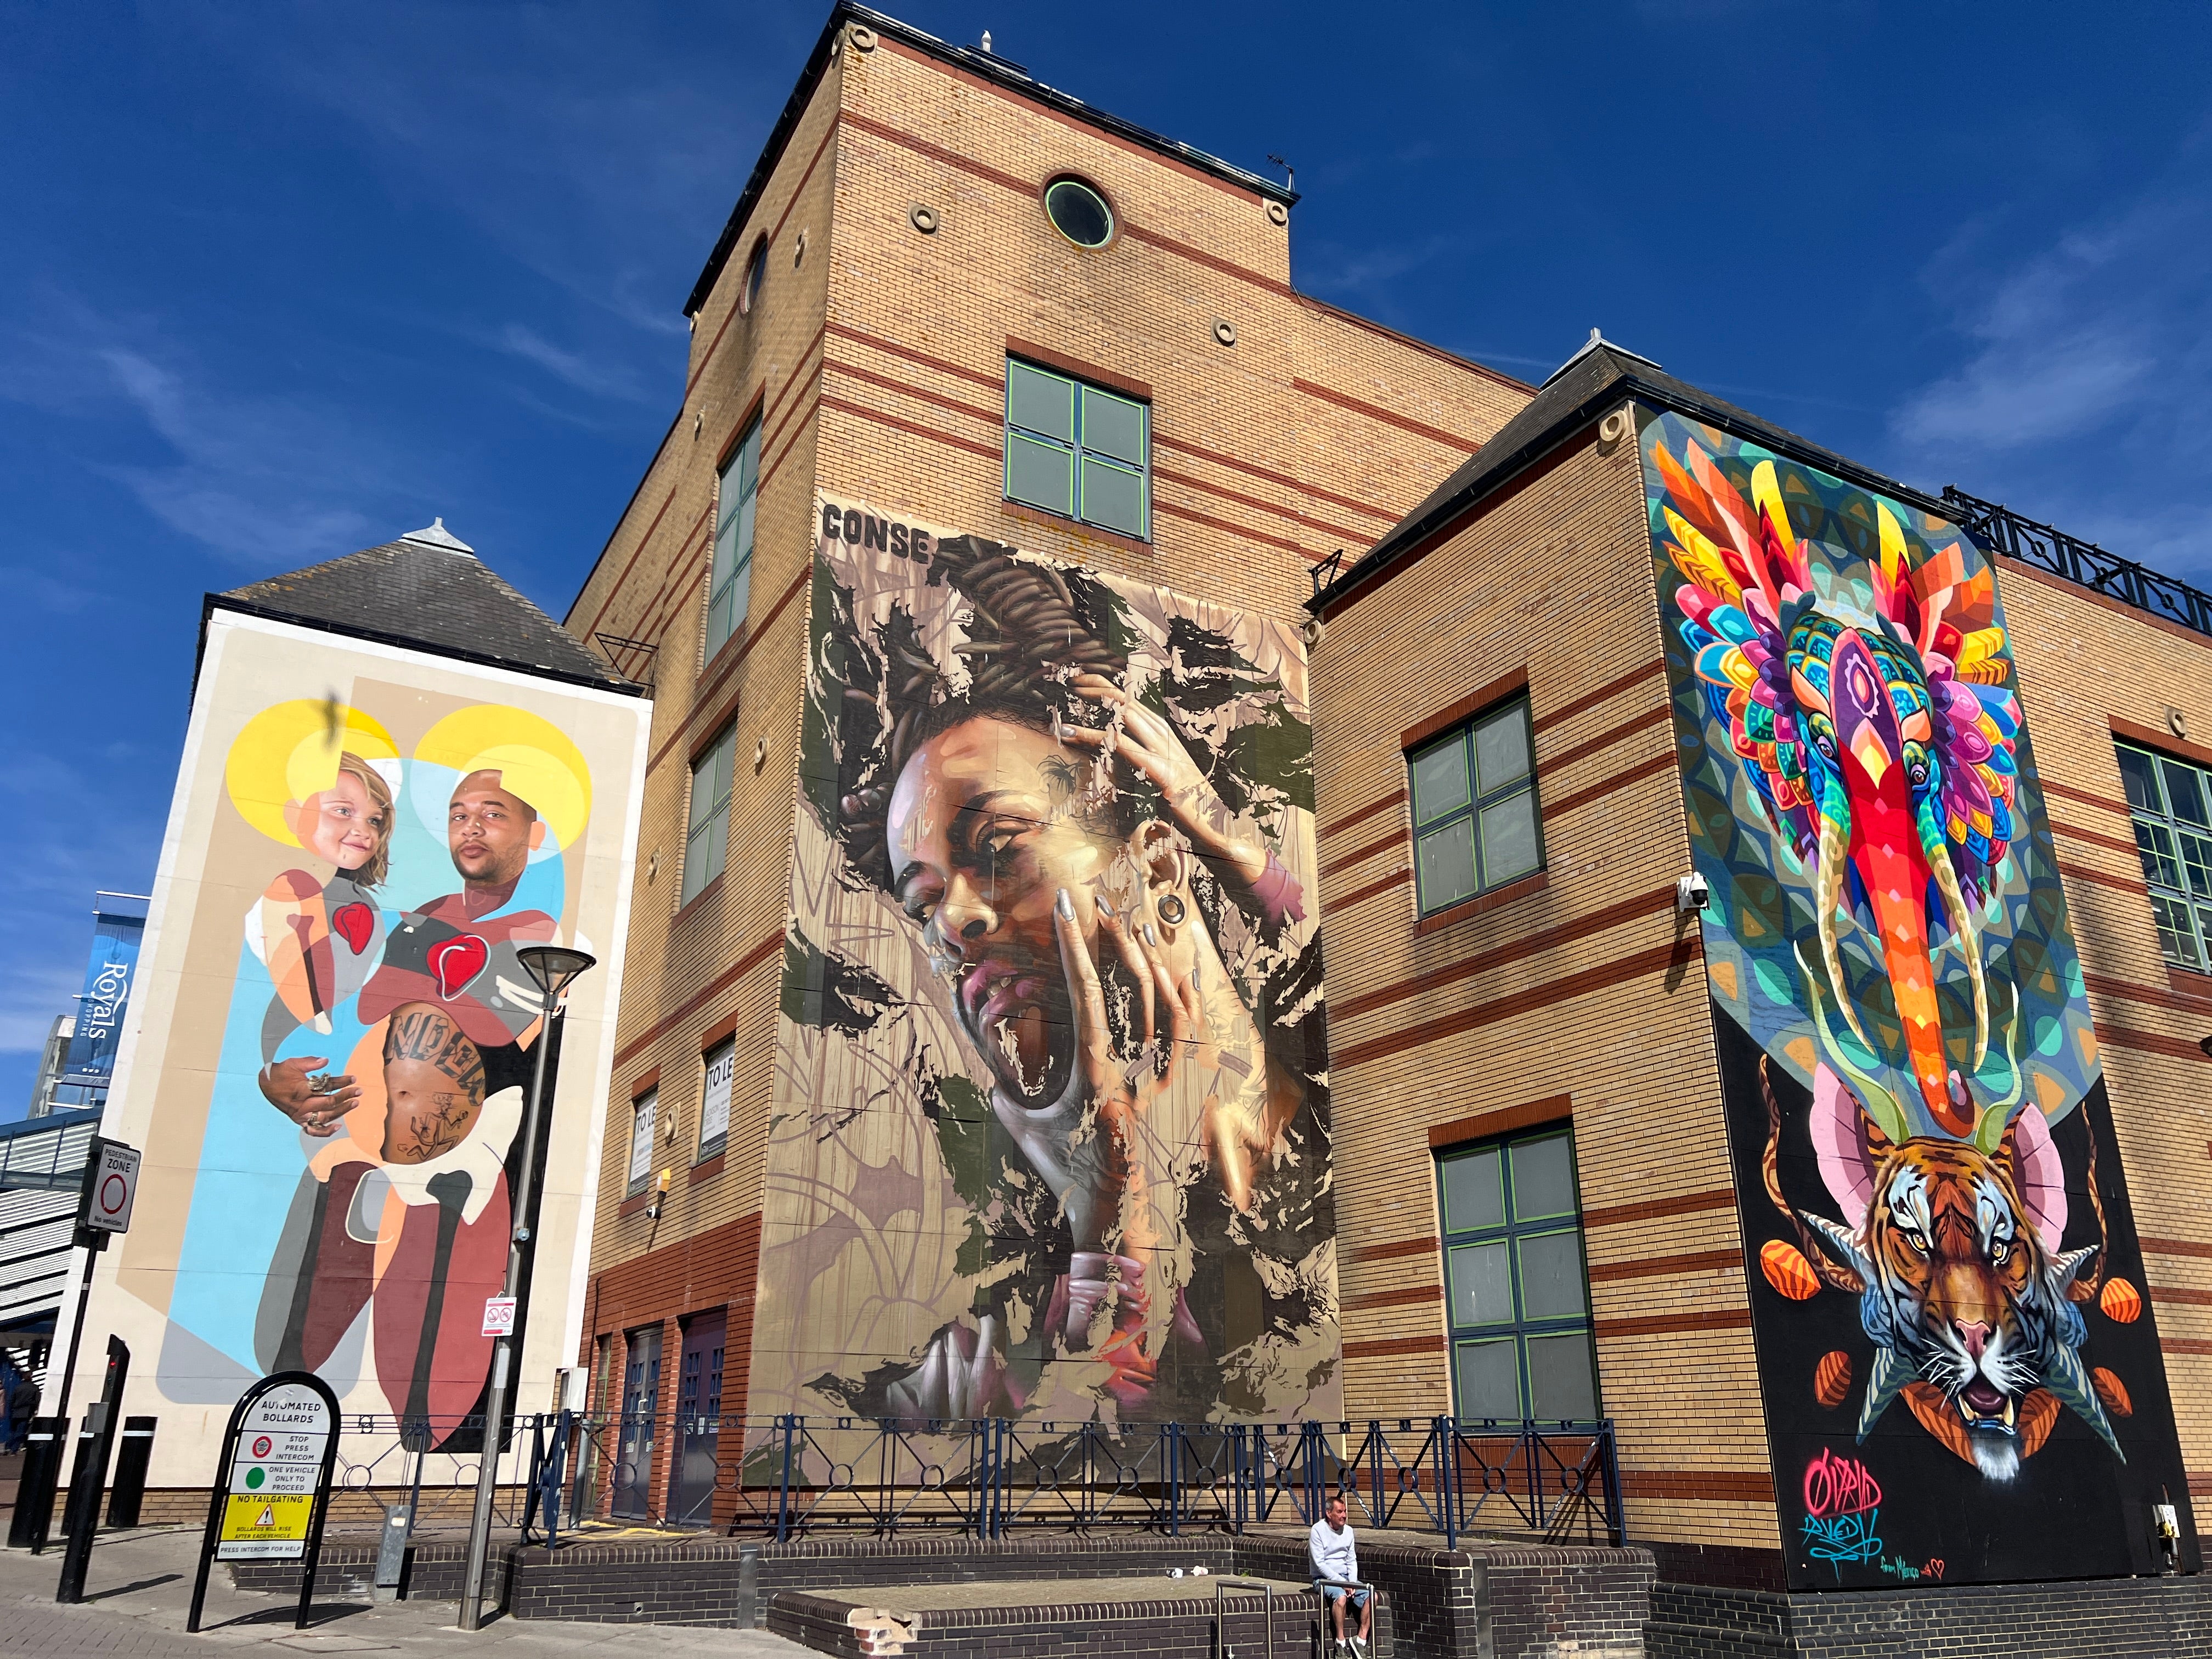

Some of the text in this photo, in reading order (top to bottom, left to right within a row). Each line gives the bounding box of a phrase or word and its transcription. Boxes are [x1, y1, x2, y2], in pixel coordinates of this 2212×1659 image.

[822, 504, 929, 565] CONSE
[88, 961, 128, 1039] Royals
[80, 998, 94, 1037] SHOPPING
[709, 1065, 720, 1090] TO
[637, 1113, 646, 1135] TO
[105, 1148, 137, 1163] PEDESTRIAN
[107, 1158, 131, 1173] ZONE
[103, 1217, 122, 1227] vehicles
[263, 1413, 314, 1423] BOLLARDS
